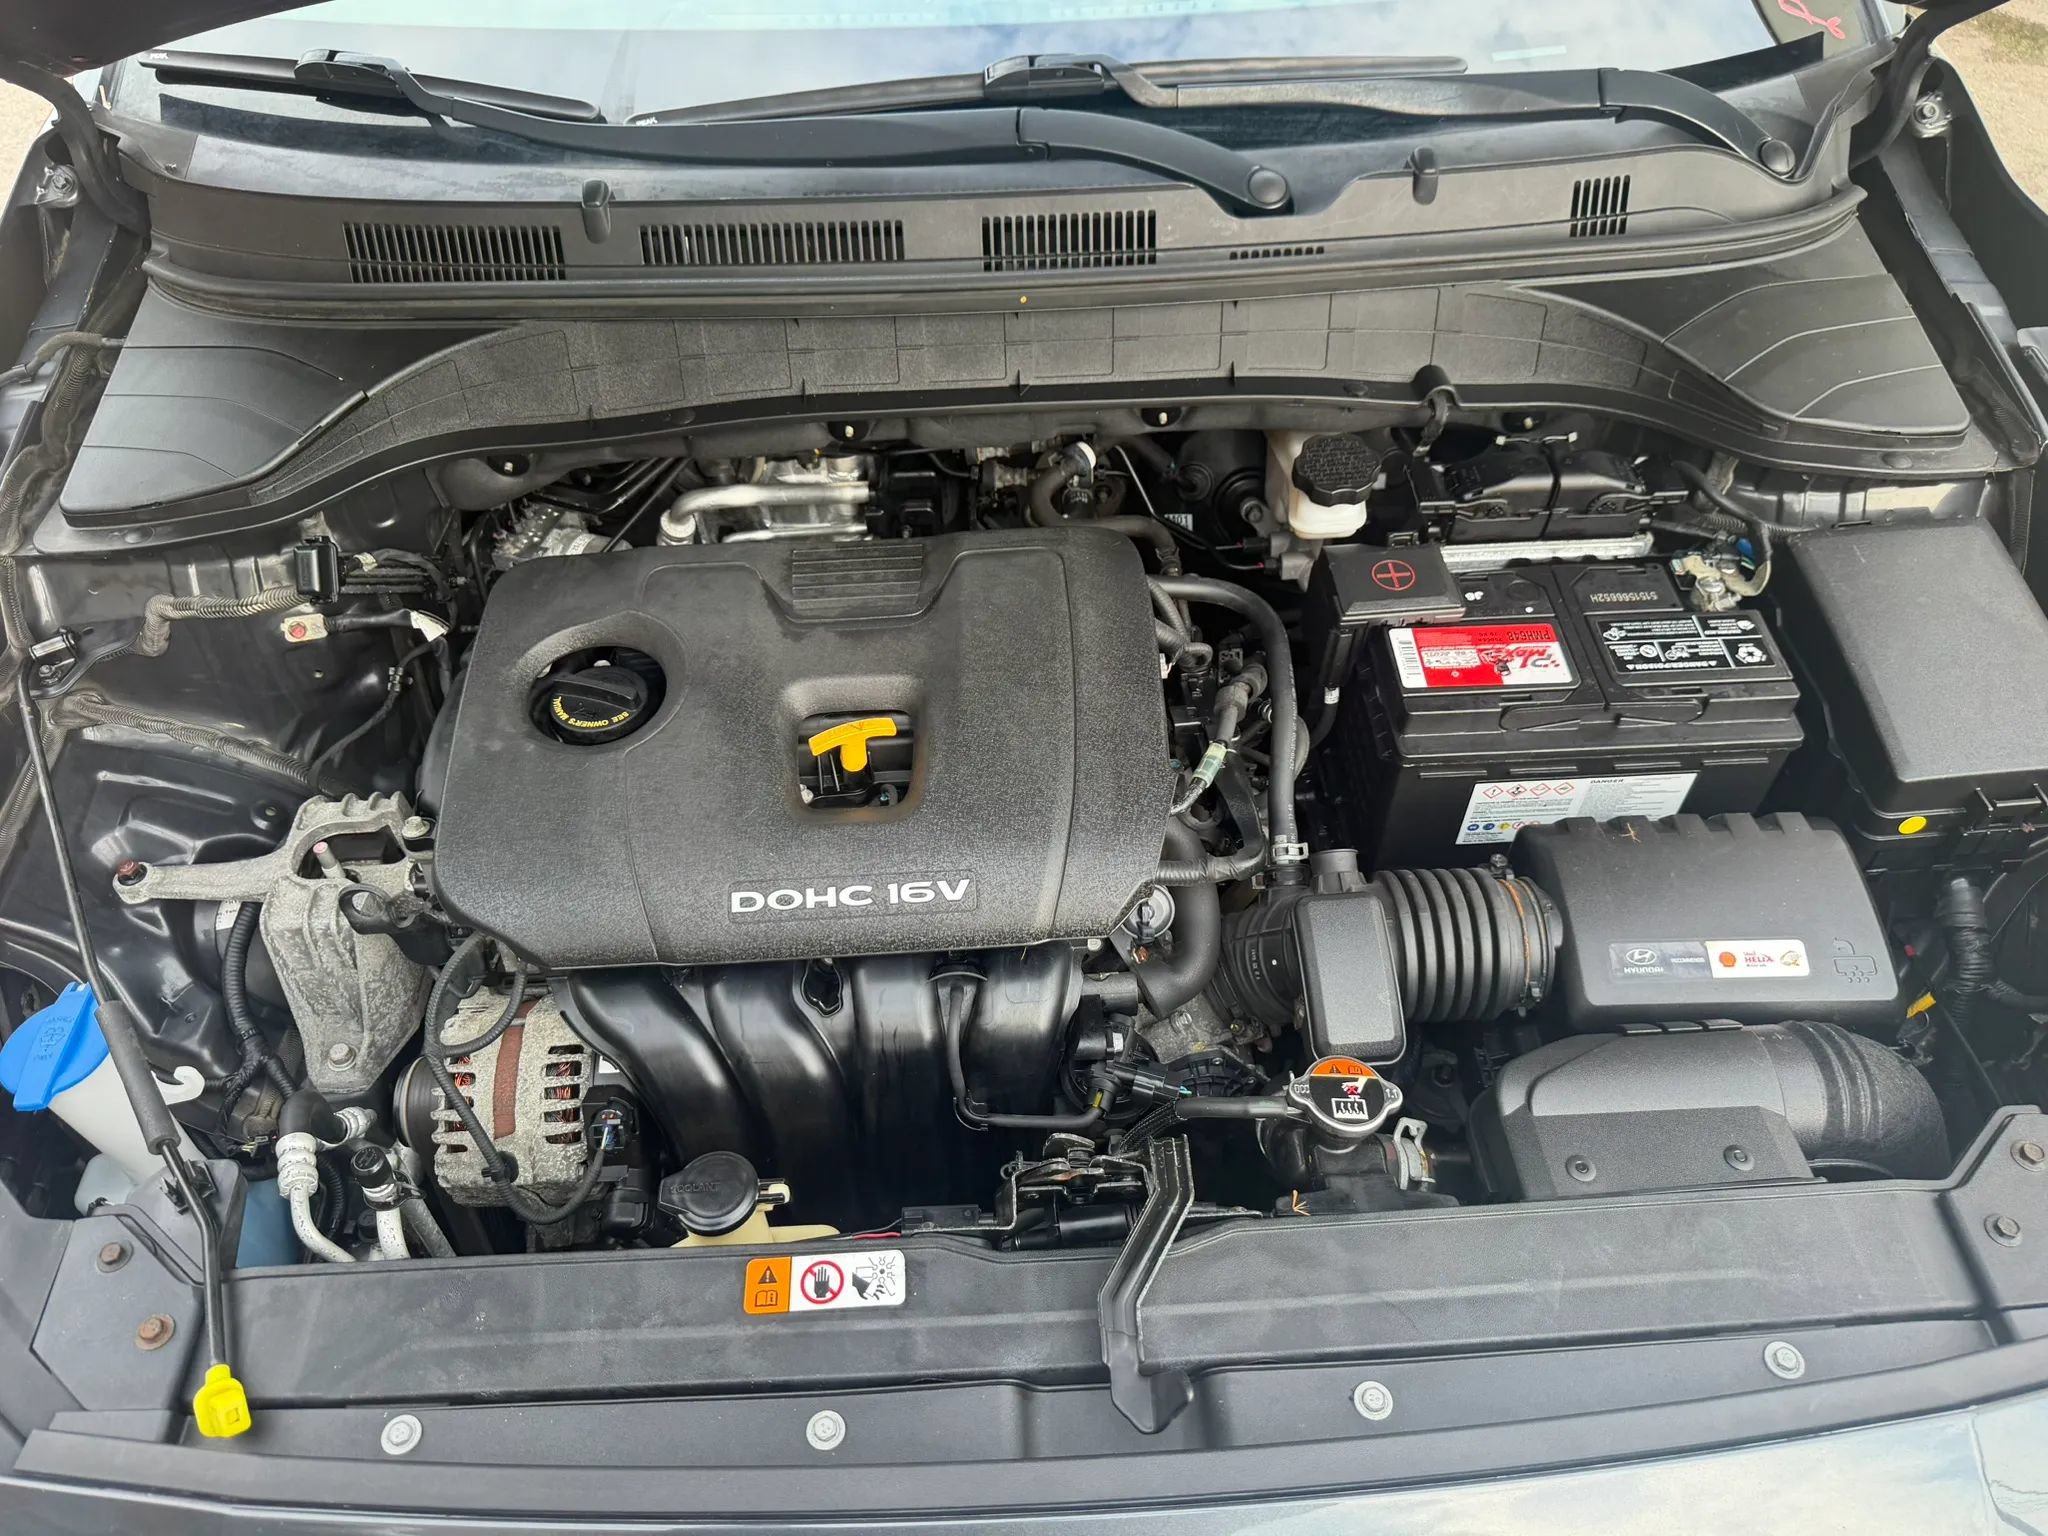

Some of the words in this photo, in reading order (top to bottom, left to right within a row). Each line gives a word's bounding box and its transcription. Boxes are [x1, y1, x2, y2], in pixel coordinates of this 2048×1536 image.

[568, 717, 609, 728] OWNER'S
[611, 711, 630, 724] SEE
[731, 885, 873, 913] DOHC
[887, 879, 970, 905] 16V
[1624, 966, 1664, 974] HYUNDAI
[1385, 1088, 1398, 1099] 1.1
